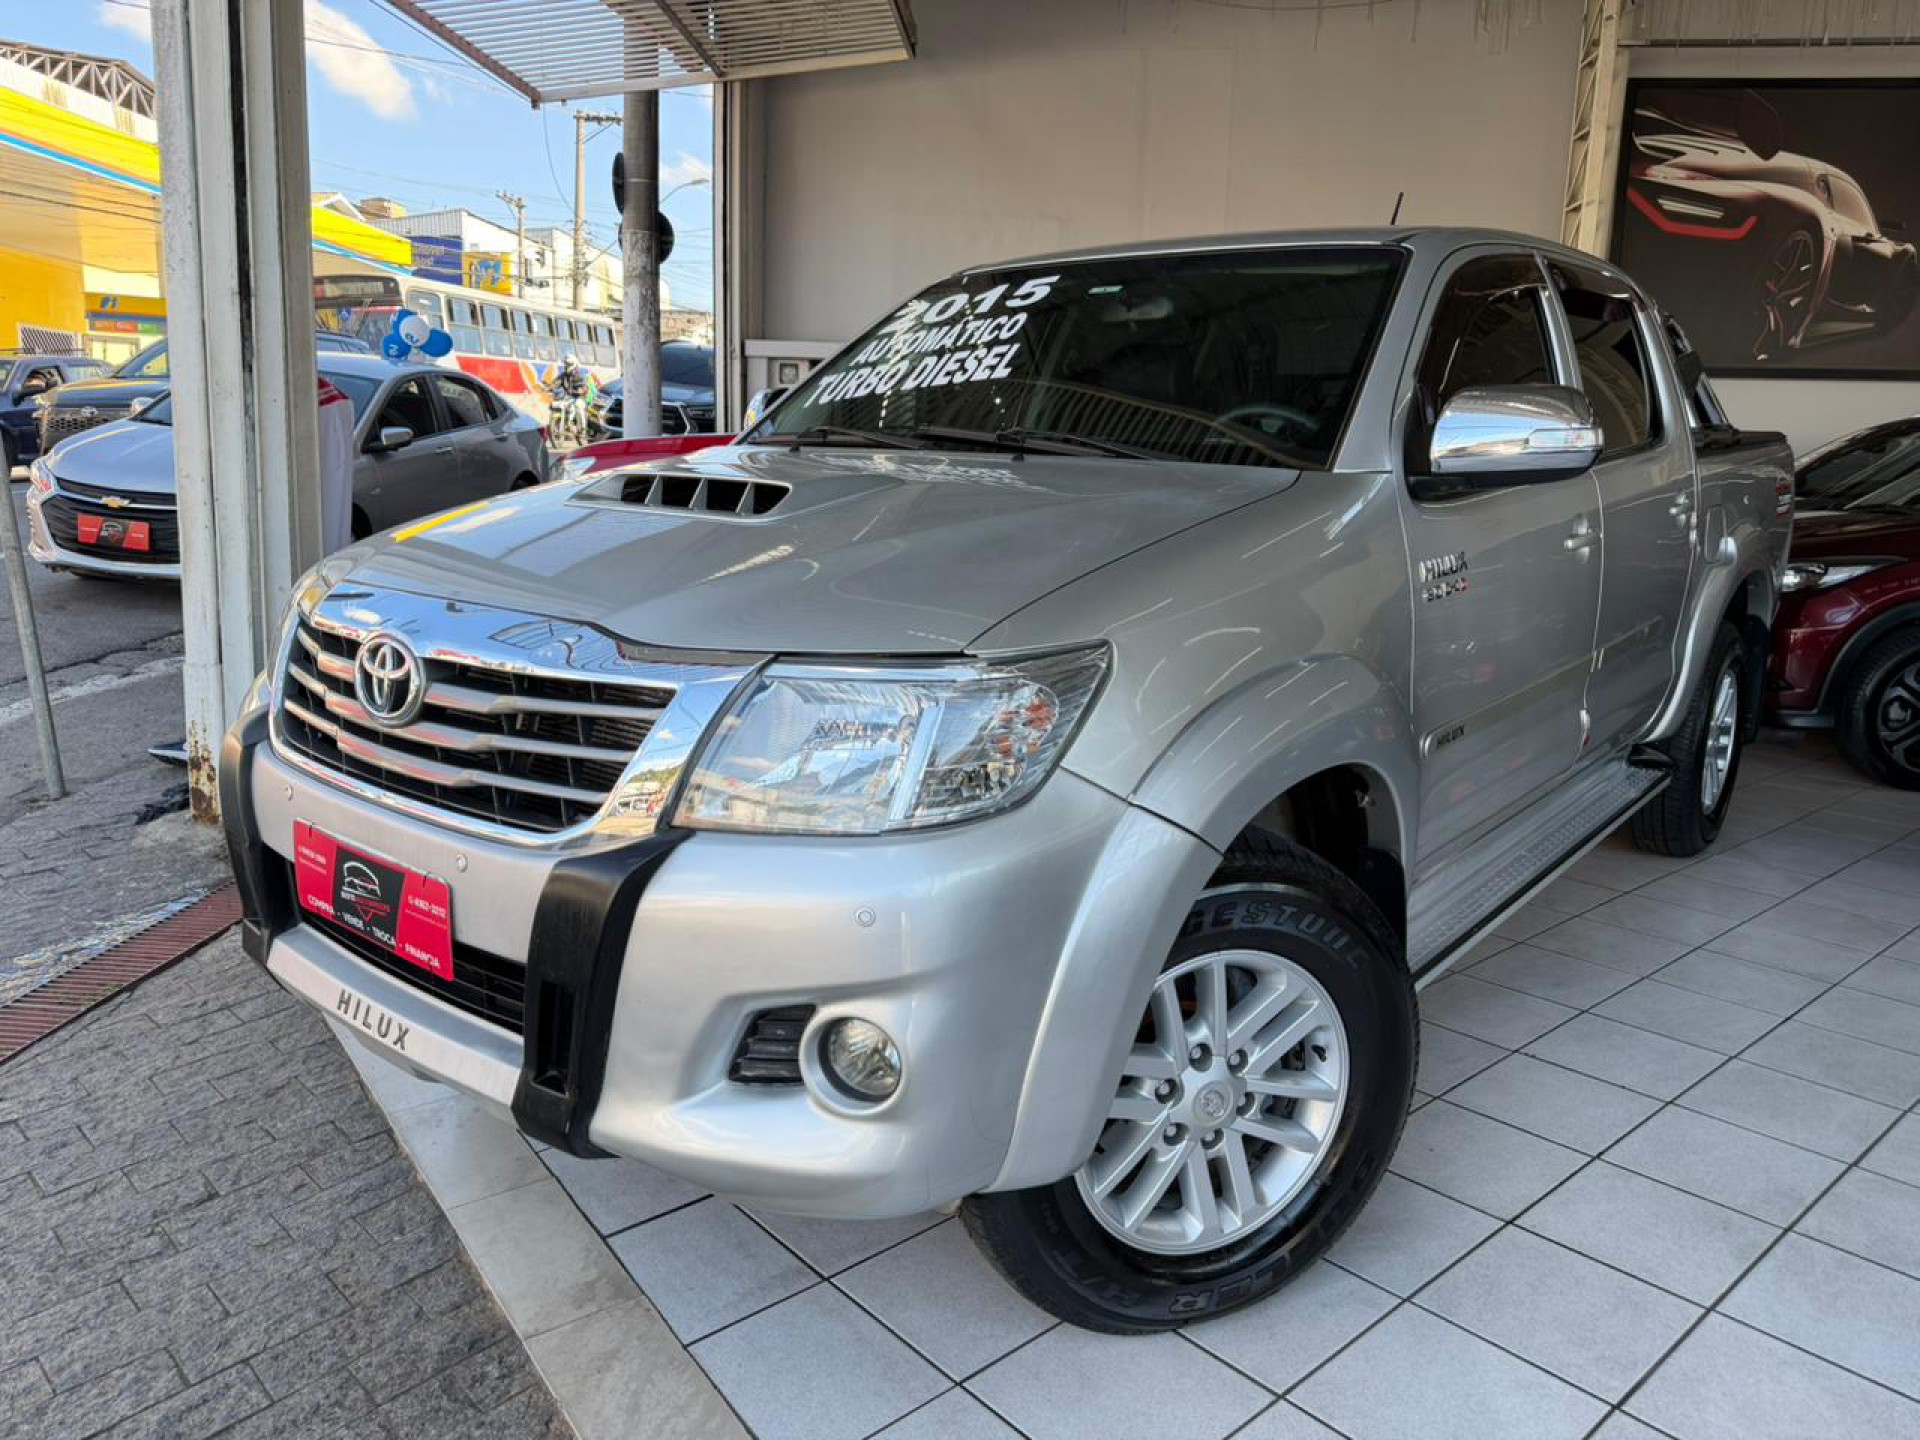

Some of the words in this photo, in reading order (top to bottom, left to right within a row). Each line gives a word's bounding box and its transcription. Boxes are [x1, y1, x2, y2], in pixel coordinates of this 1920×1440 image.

[879, 275, 1060, 335] 2015
[849, 312, 1028, 366] AUTOMÁTICO
[803, 360, 911, 408] TURBO
[901, 343, 1021, 391] DIESEL
[1418, 551, 1468, 583] HILUX
[337, 988, 411, 1051] HILUX
